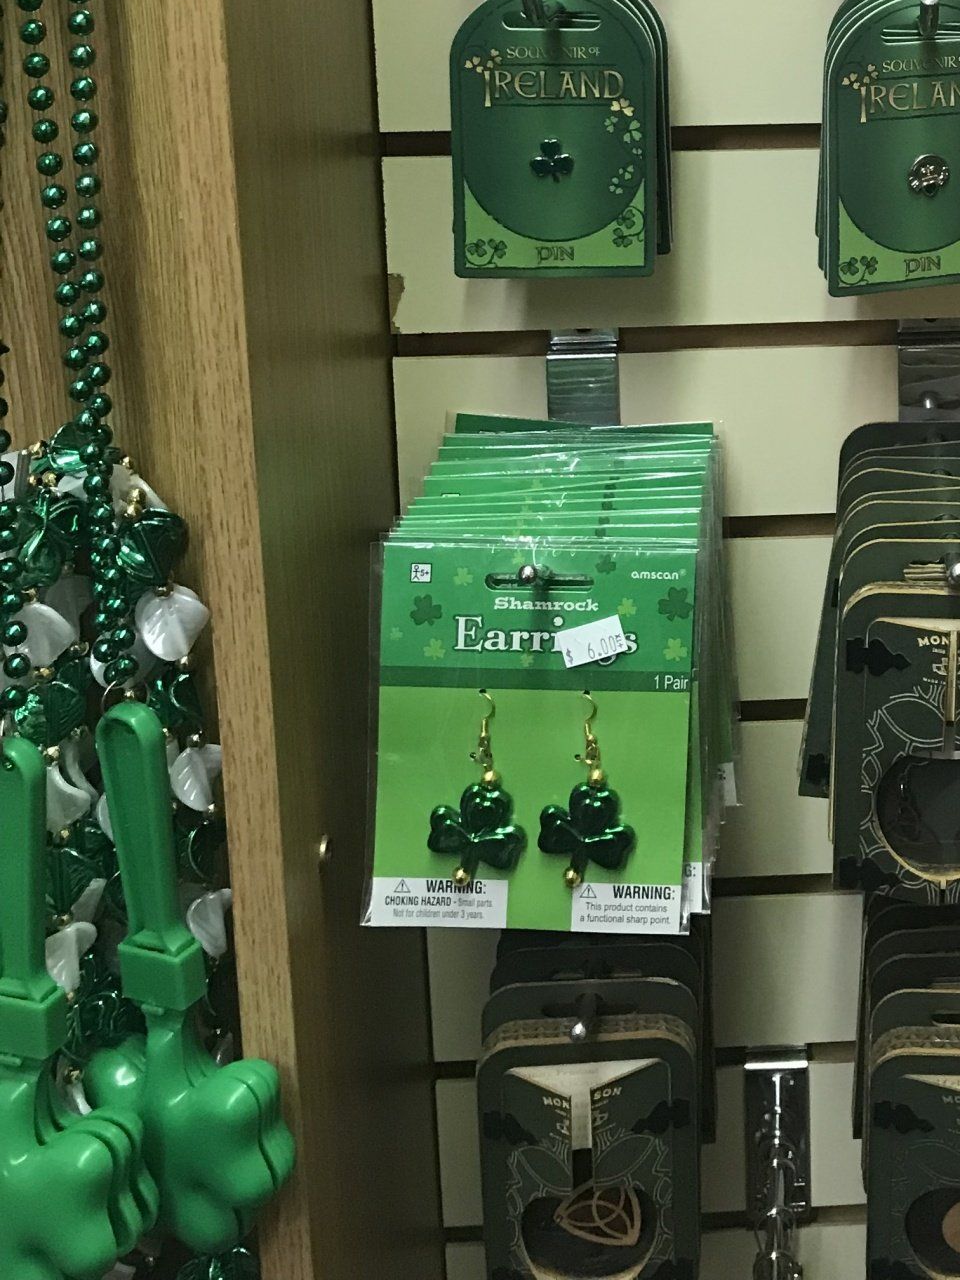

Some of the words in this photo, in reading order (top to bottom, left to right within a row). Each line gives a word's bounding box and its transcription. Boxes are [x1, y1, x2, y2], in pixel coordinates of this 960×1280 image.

[506, 46, 586, 59] SOUVNIR
[483, 70, 624, 107] IRELAND
[535, 246, 575, 265] PIN
[904, 256, 941, 277] PIN
[493, 596, 599, 612] Shamrock
[454, 616, 638, 665] Earris
[588, 636, 617, 659] 6.00
[654, 674, 660, 689] 1
[664, 674, 689, 690] Pair
[612, 885, 676, 900] WARNING:
[384, 895, 419, 906] CHOKING
[421, 896, 452, 907] HAZARD
[586, 901, 602, 910] This
[603, 902, 633, 912] product
[635, 903, 668, 913] contains
[442, 909, 459, 919] under
[587, 914, 624, 923] functional
[626, 915, 648, 925] sharp
